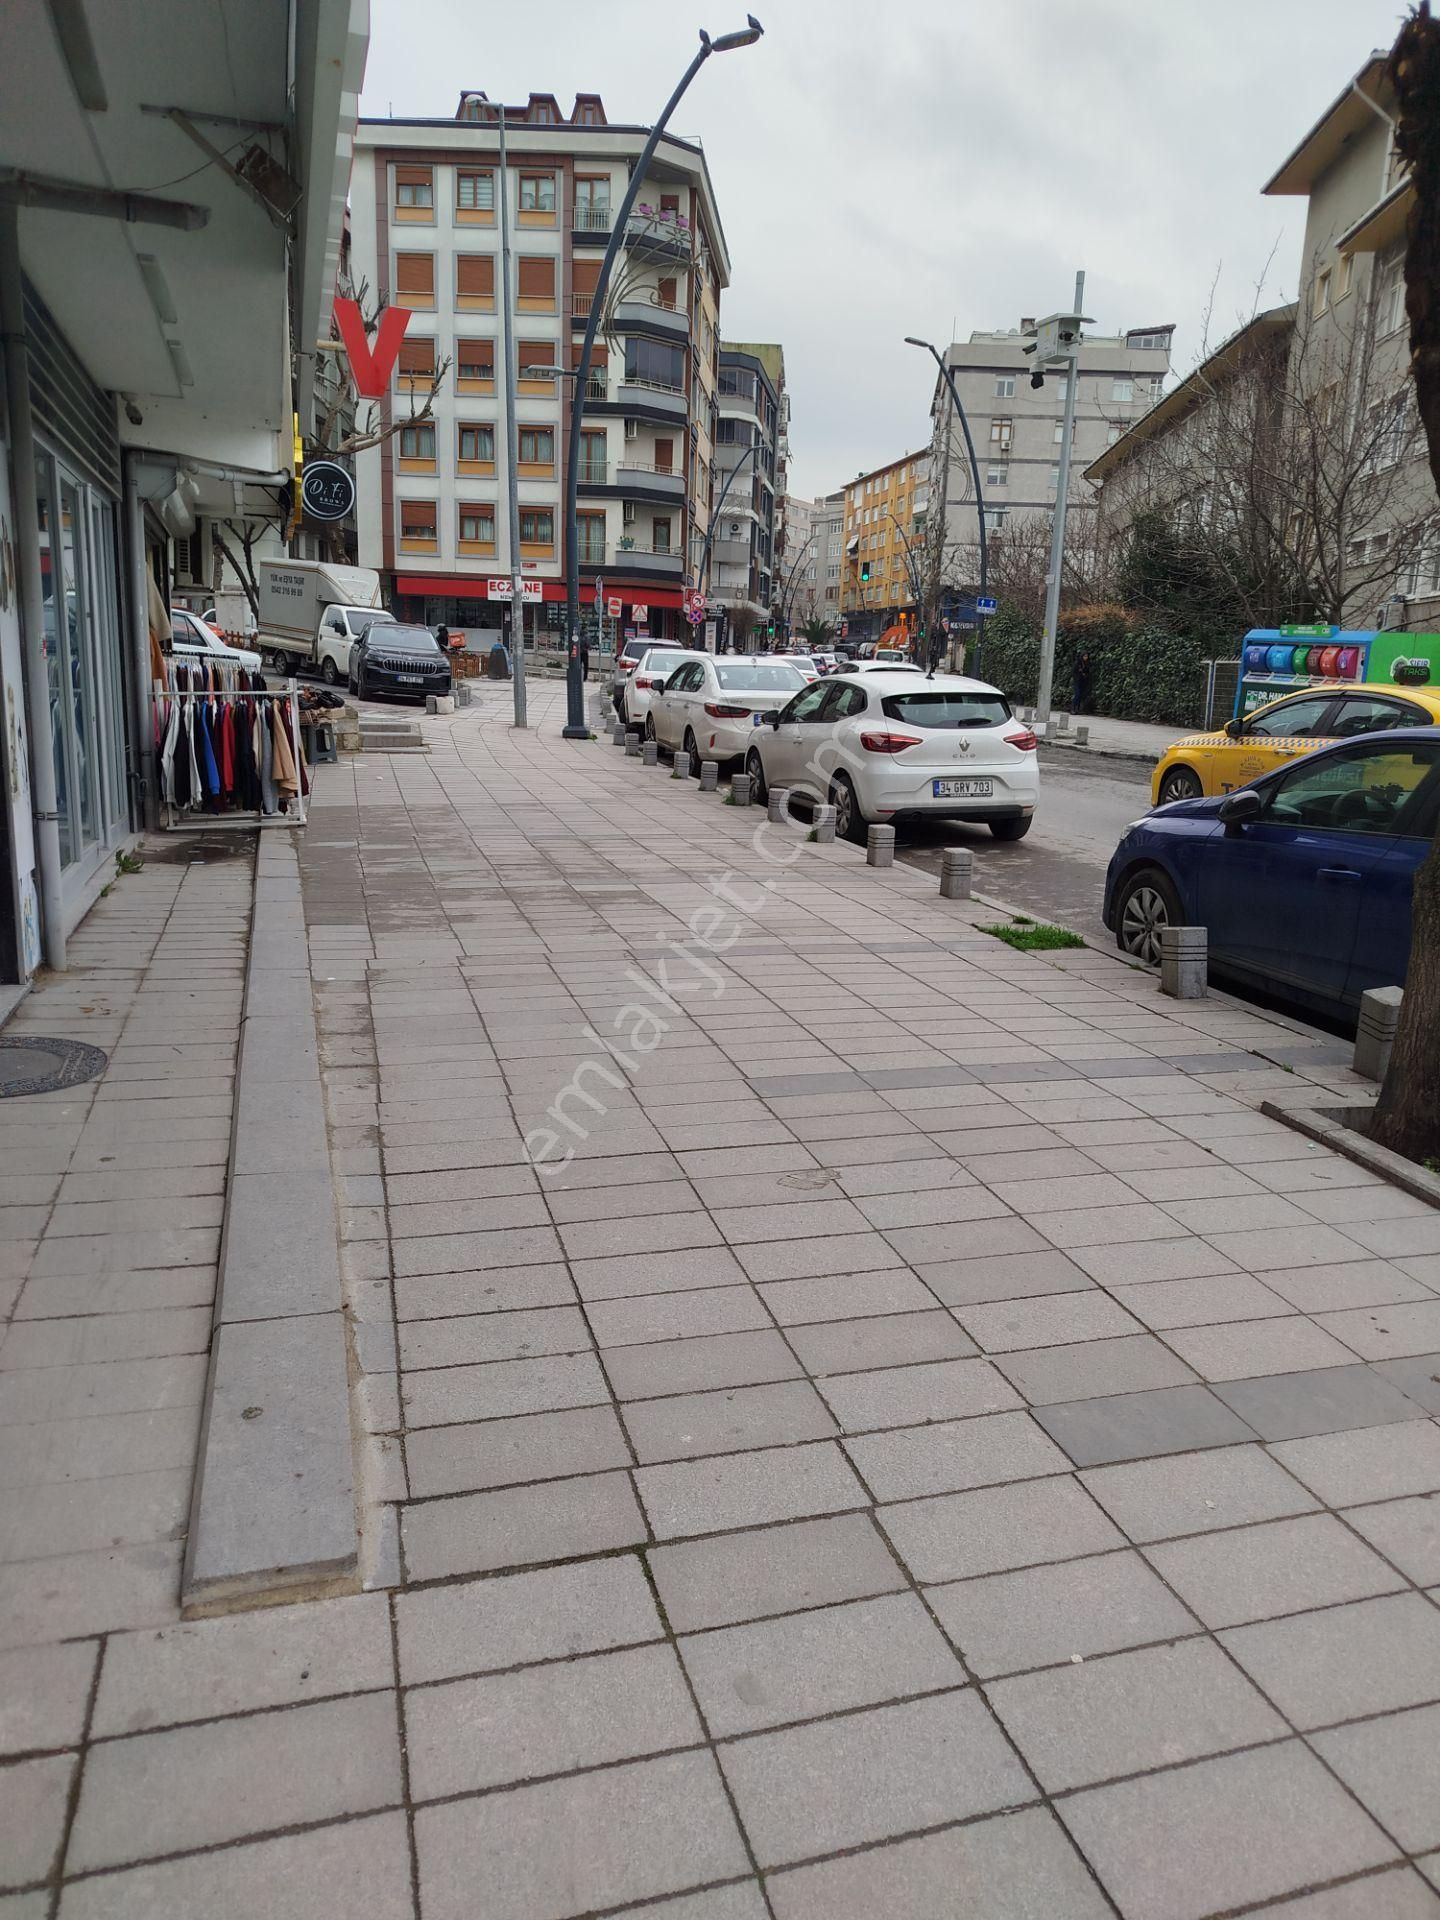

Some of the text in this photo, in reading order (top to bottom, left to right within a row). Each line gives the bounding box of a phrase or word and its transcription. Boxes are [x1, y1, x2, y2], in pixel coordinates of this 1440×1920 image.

[333, 297, 413, 399] V
[489, 581, 541, 593] ECZNE
[940, 782, 951, 793] 34
[974, 781, 990, 793] 703
